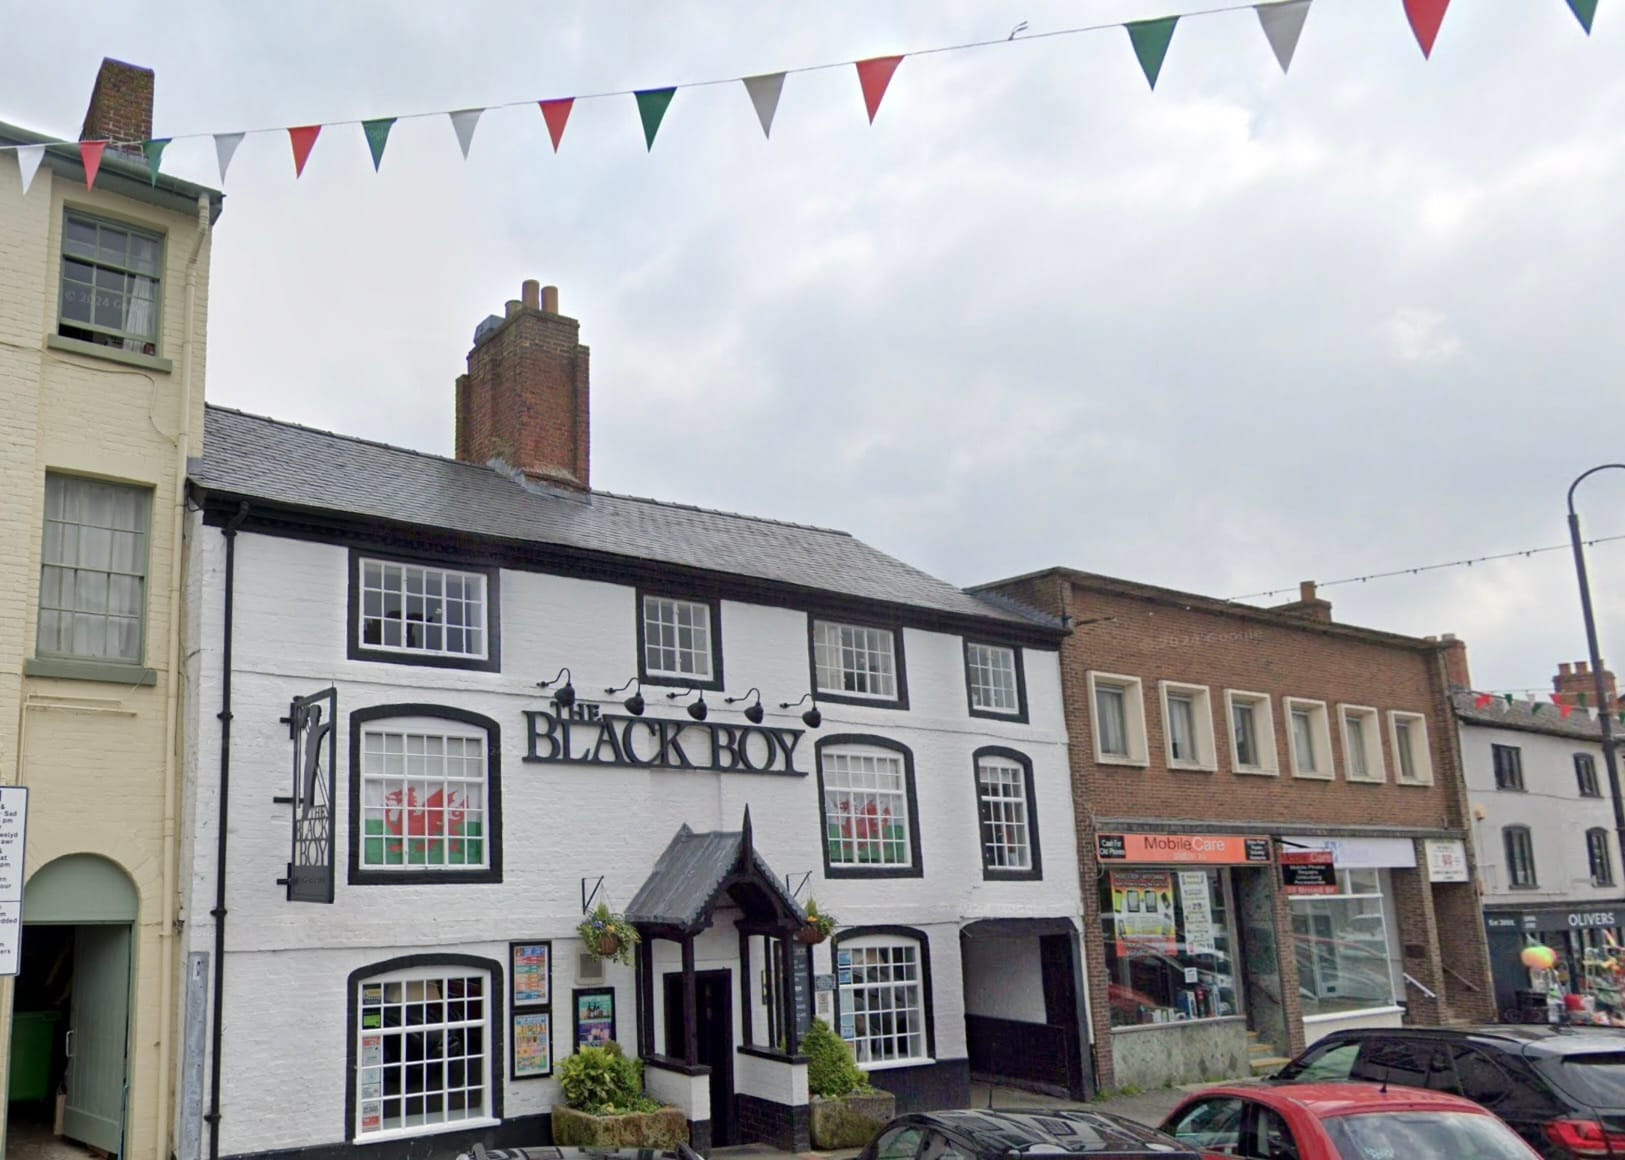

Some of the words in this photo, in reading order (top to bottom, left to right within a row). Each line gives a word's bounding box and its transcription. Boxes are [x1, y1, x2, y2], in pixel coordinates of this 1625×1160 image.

[521, 710, 694, 770] BLACK
[709, 723, 809, 777] BOY
[300, 841, 329, 867] BOY
[1567, 913, 1615, 926] OLIVERS
